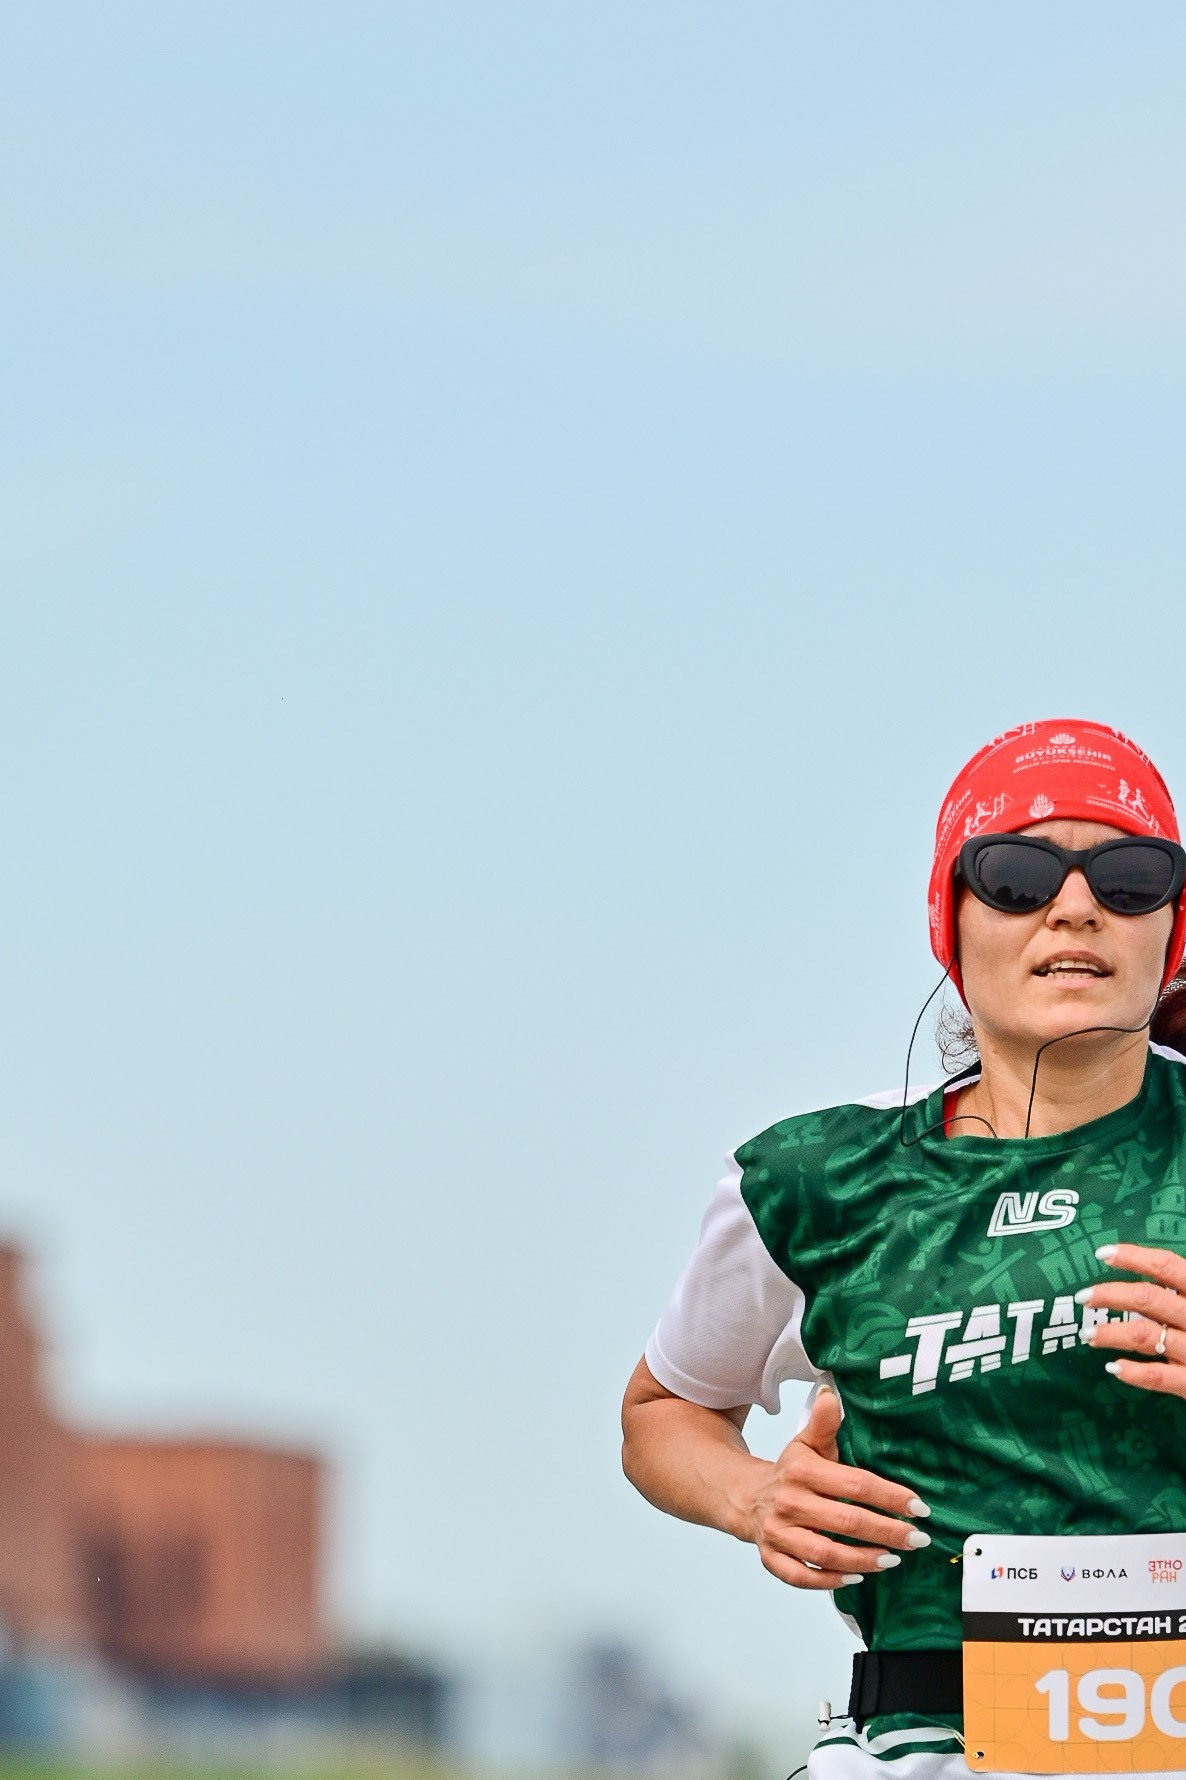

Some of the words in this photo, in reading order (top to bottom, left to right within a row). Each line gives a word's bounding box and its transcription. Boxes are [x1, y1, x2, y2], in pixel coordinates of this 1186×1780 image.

[987, 1189, 1079, 1237] NS
[1147, 1560, 1183, 1572] ЭТНО
[1007, 1567, 1038, 1580] ПСБ
[1082, 1568, 1128, 1579] ВФЛА
[1152, 1571, 1177, 1583] РАН
[1018, 1616, 1172, 1636] ТАТАРСТАН
